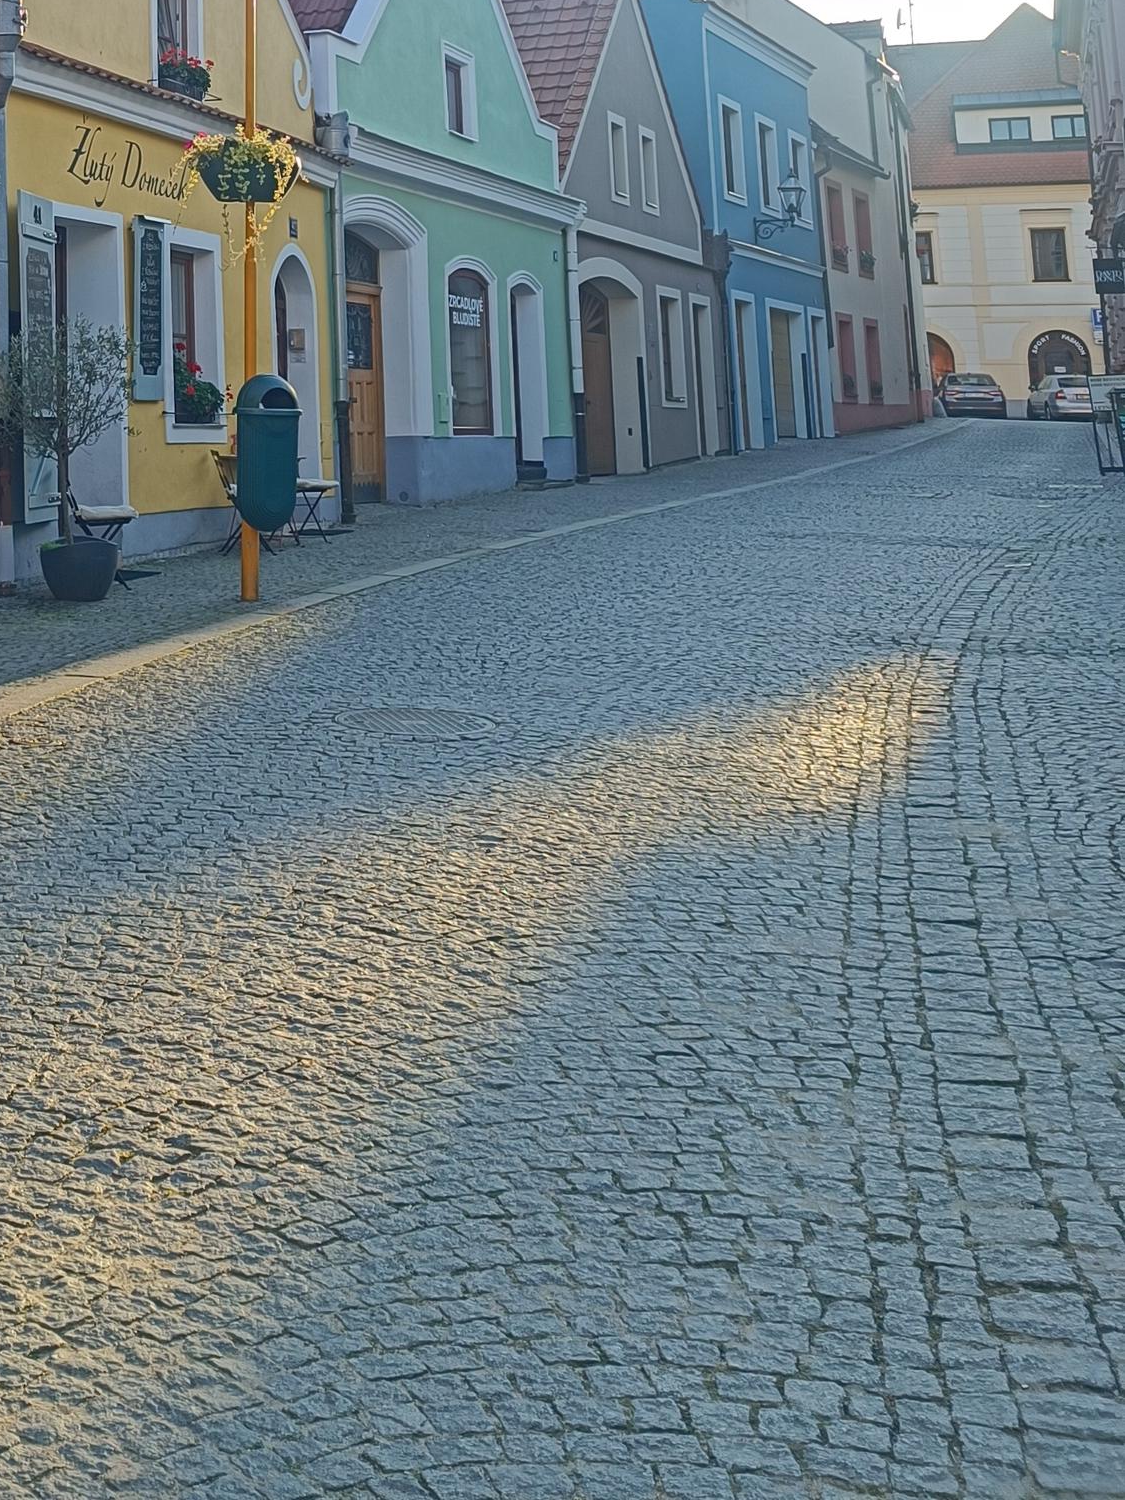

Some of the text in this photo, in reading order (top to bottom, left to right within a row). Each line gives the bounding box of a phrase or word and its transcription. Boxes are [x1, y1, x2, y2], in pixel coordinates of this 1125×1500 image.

[67, 114, 187, 207] Žlutý Domeček
[448, 294, 483, 313] ZRCADLOVÉ
[1031, 334, 1050, 354] SPORT
[1061, 333, 1087, 356] FASHION
